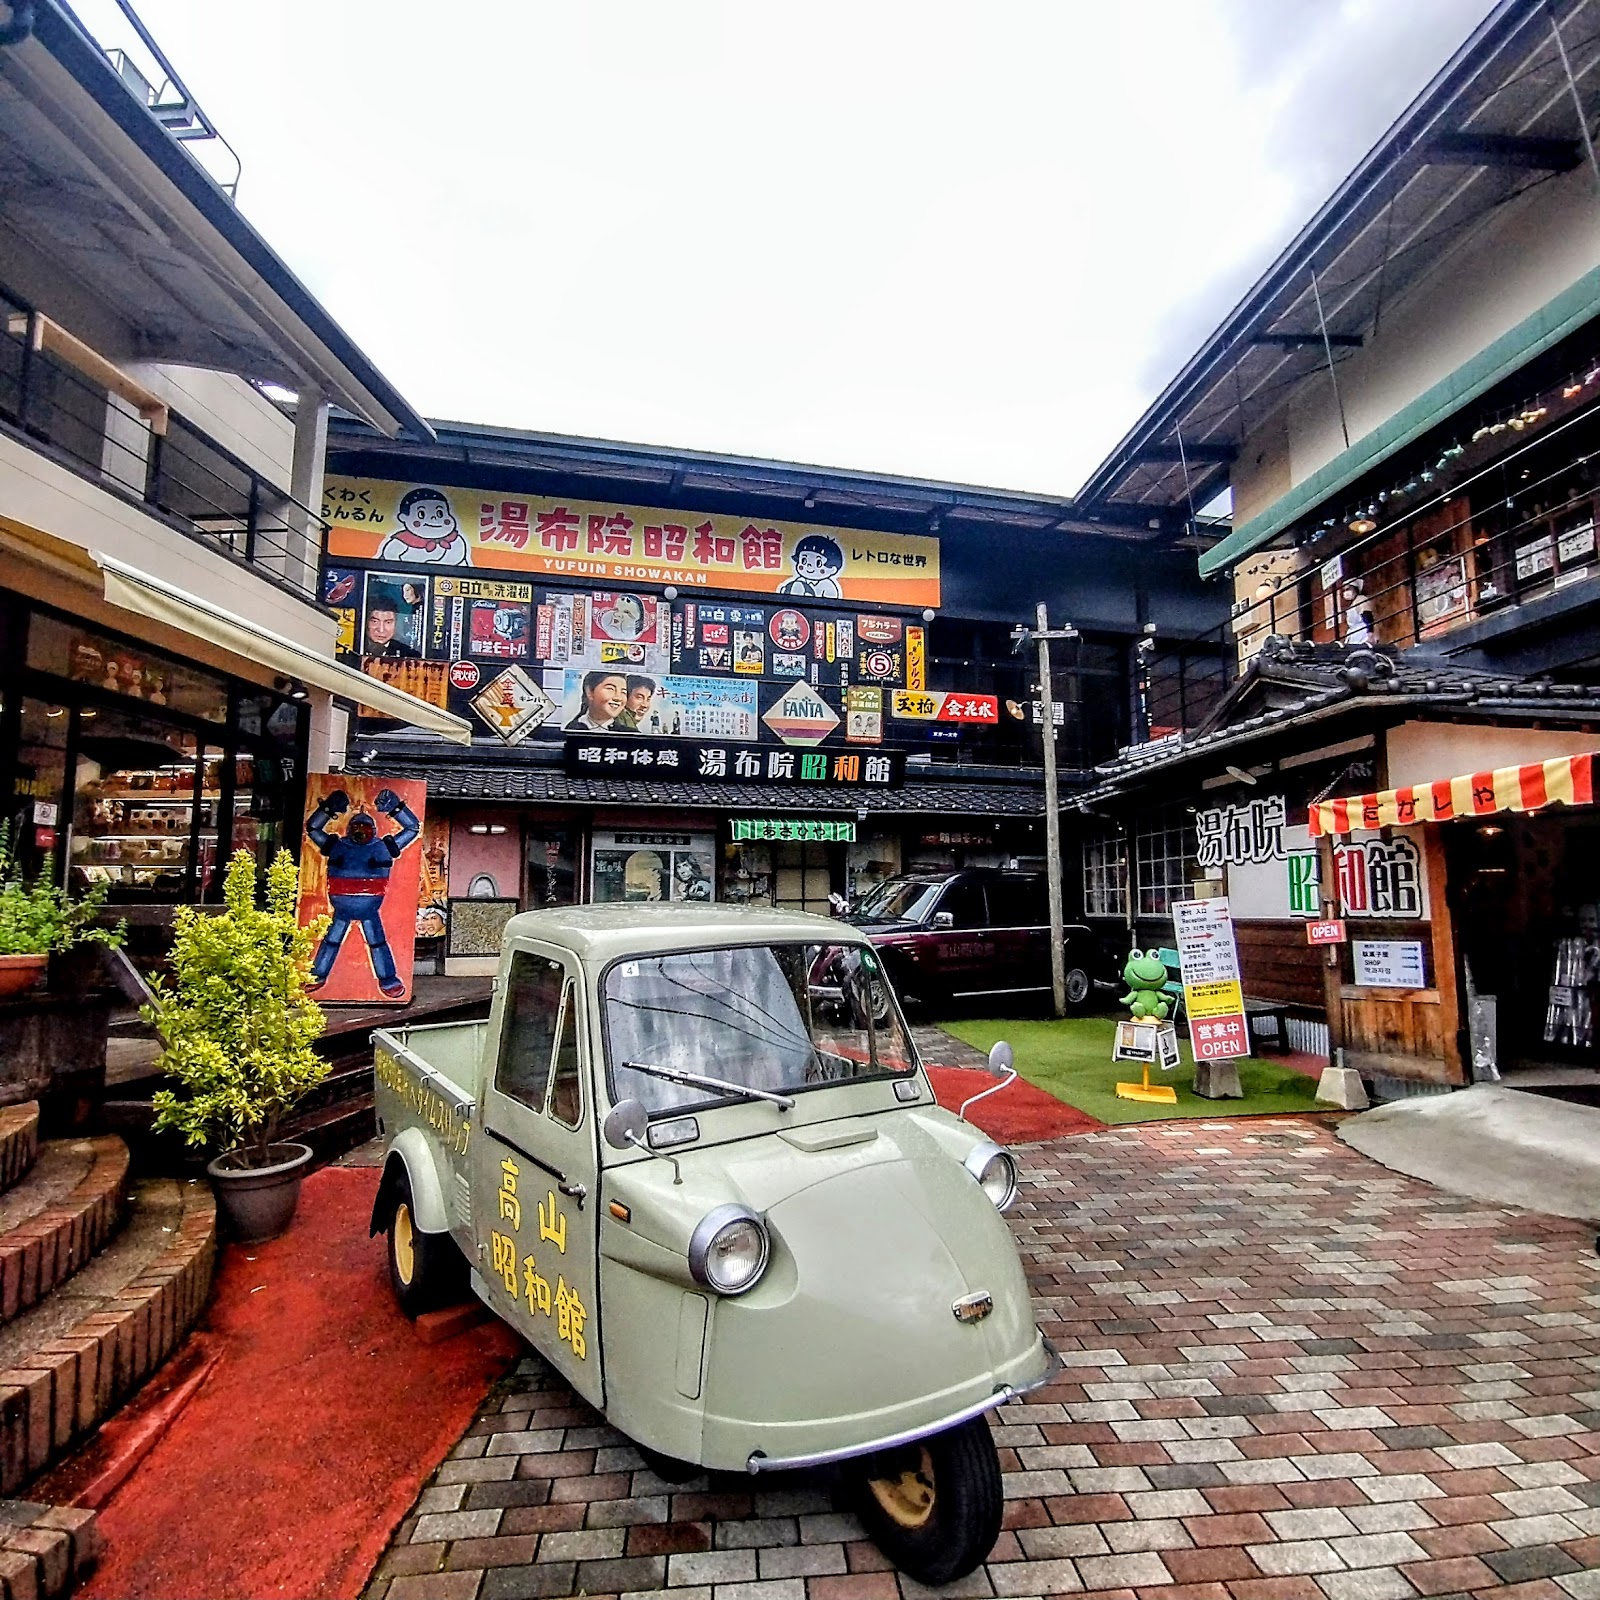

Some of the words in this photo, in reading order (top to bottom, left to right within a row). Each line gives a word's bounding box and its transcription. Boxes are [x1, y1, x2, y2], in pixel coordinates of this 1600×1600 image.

[479, 502, 785, 570] 湯布院昭和館
[851, 548, 927, 568] レトロな世界
[543, 559, 607, 576] YUFUIN
[613, 569, 707, 584] SHOWAKAN
[860, 619, 898, 630] フジカラー
[471, 640, 527, 656] 東芝モートル
[452, 669, 478, 682] 消火栓
[850, 690, 879, 701] ヤンマー
[782, 700, 825, 718] FANTA
[577, 747, 680, 767] 昭和体感
[698, 748, 891, 783] 湯布院昭和館
[1362, 785, 1495, 822] だがしや
[762, 825, 827, 838] あさひや
[1196, 794, 1288, 867] 湯布院
[1181, 917, 1208, 925] Reception
[1312, 925, 1338, 939] OPEN
[1197, 1020, 1241, 1040] 営業中
[1202, 1039, 1241, 1056] OPEN
[498, 1155, 568, 1255] 高山
[490, 1228, 588, 1361] 昭和館
